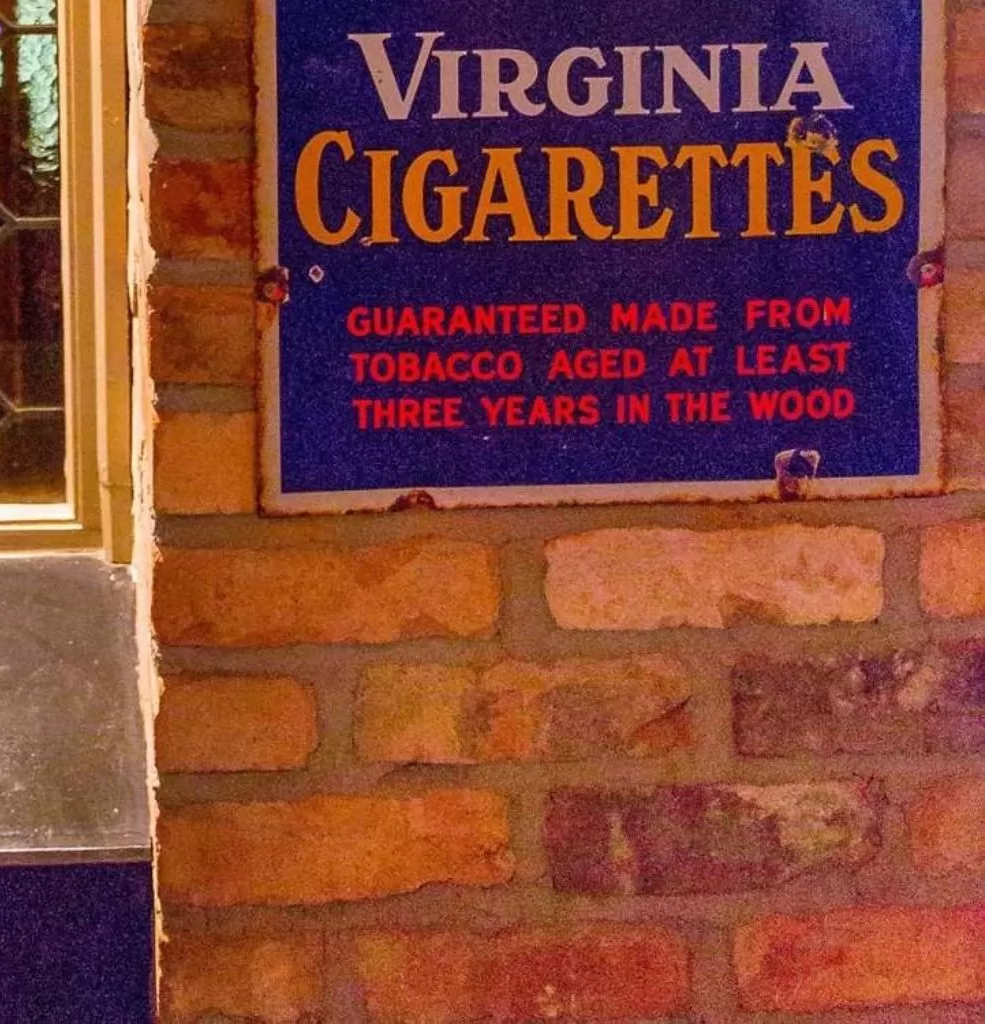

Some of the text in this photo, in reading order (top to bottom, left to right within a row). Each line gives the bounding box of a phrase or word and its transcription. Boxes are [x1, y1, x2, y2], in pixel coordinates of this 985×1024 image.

[348, 31, 854, 122] VIRGINIA
[294, 129, 905, 247] CIGARETTES
[346, 298, 852, 338] GUARANTEED MADE FROM
[350, 342, 853, 384] TOBACCO AGED AT LEAST
[352, 388, 855, 430] THREE YEARS IN THE WOOD
